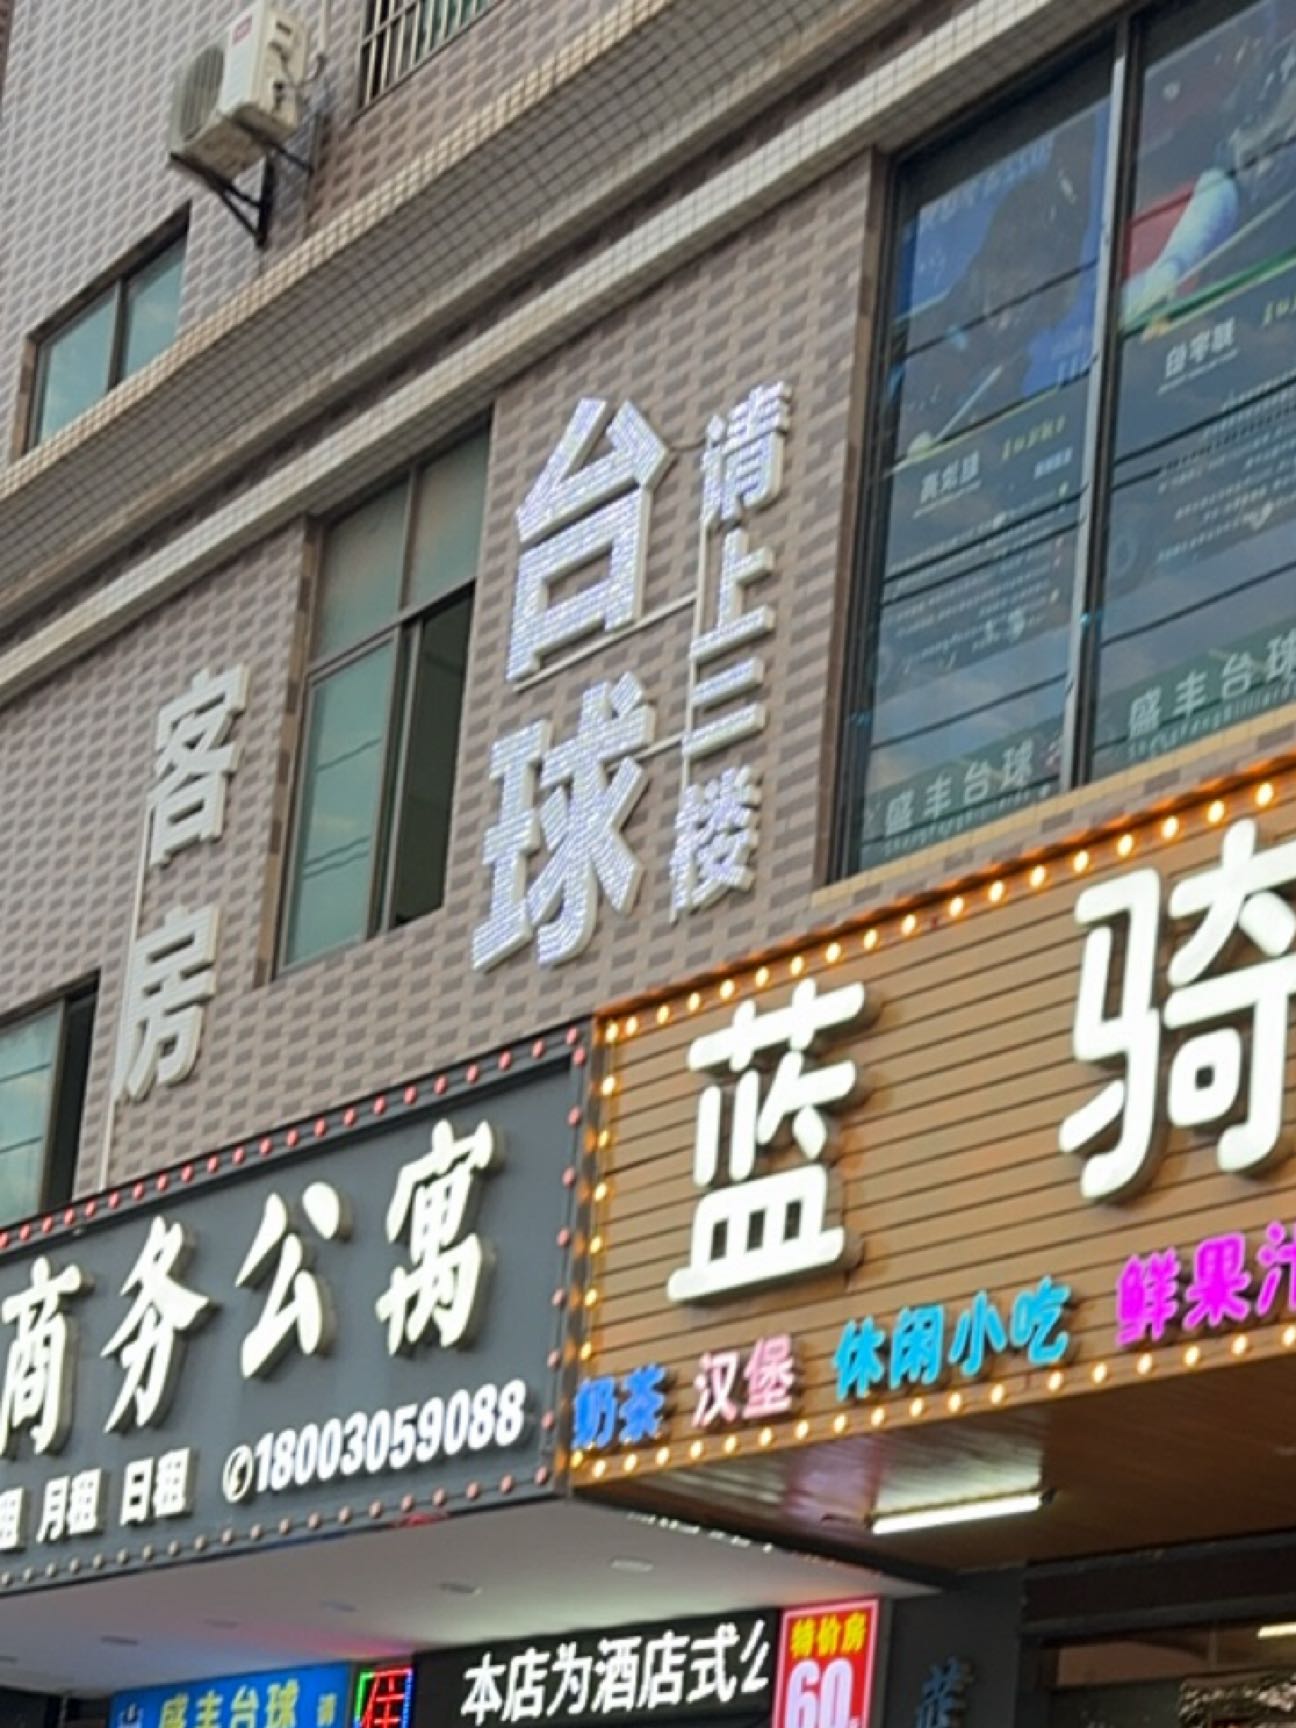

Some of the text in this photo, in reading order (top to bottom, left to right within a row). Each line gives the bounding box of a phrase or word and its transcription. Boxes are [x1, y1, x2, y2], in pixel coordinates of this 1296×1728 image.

[472, 397, 670, 972] 台球
[669, 380, 792, 923] 请上二楼
[884, 738, 1033, 837] 盛丰台球
[112, 661, 249, 1104] 客房
[0, 1119, 495, 1456] 商务公寓
[571, 1363, 668, 1450] 奶茶
[691, 1332, 796, 1428] 汉堡
[833, 1275, 1072, 1402] 休闲小吃
[36, 1468, 101, 1543] 月租
[120, 1447, 191, 1527] 日租
[254, 1379, 528, 1494] 18003059088
